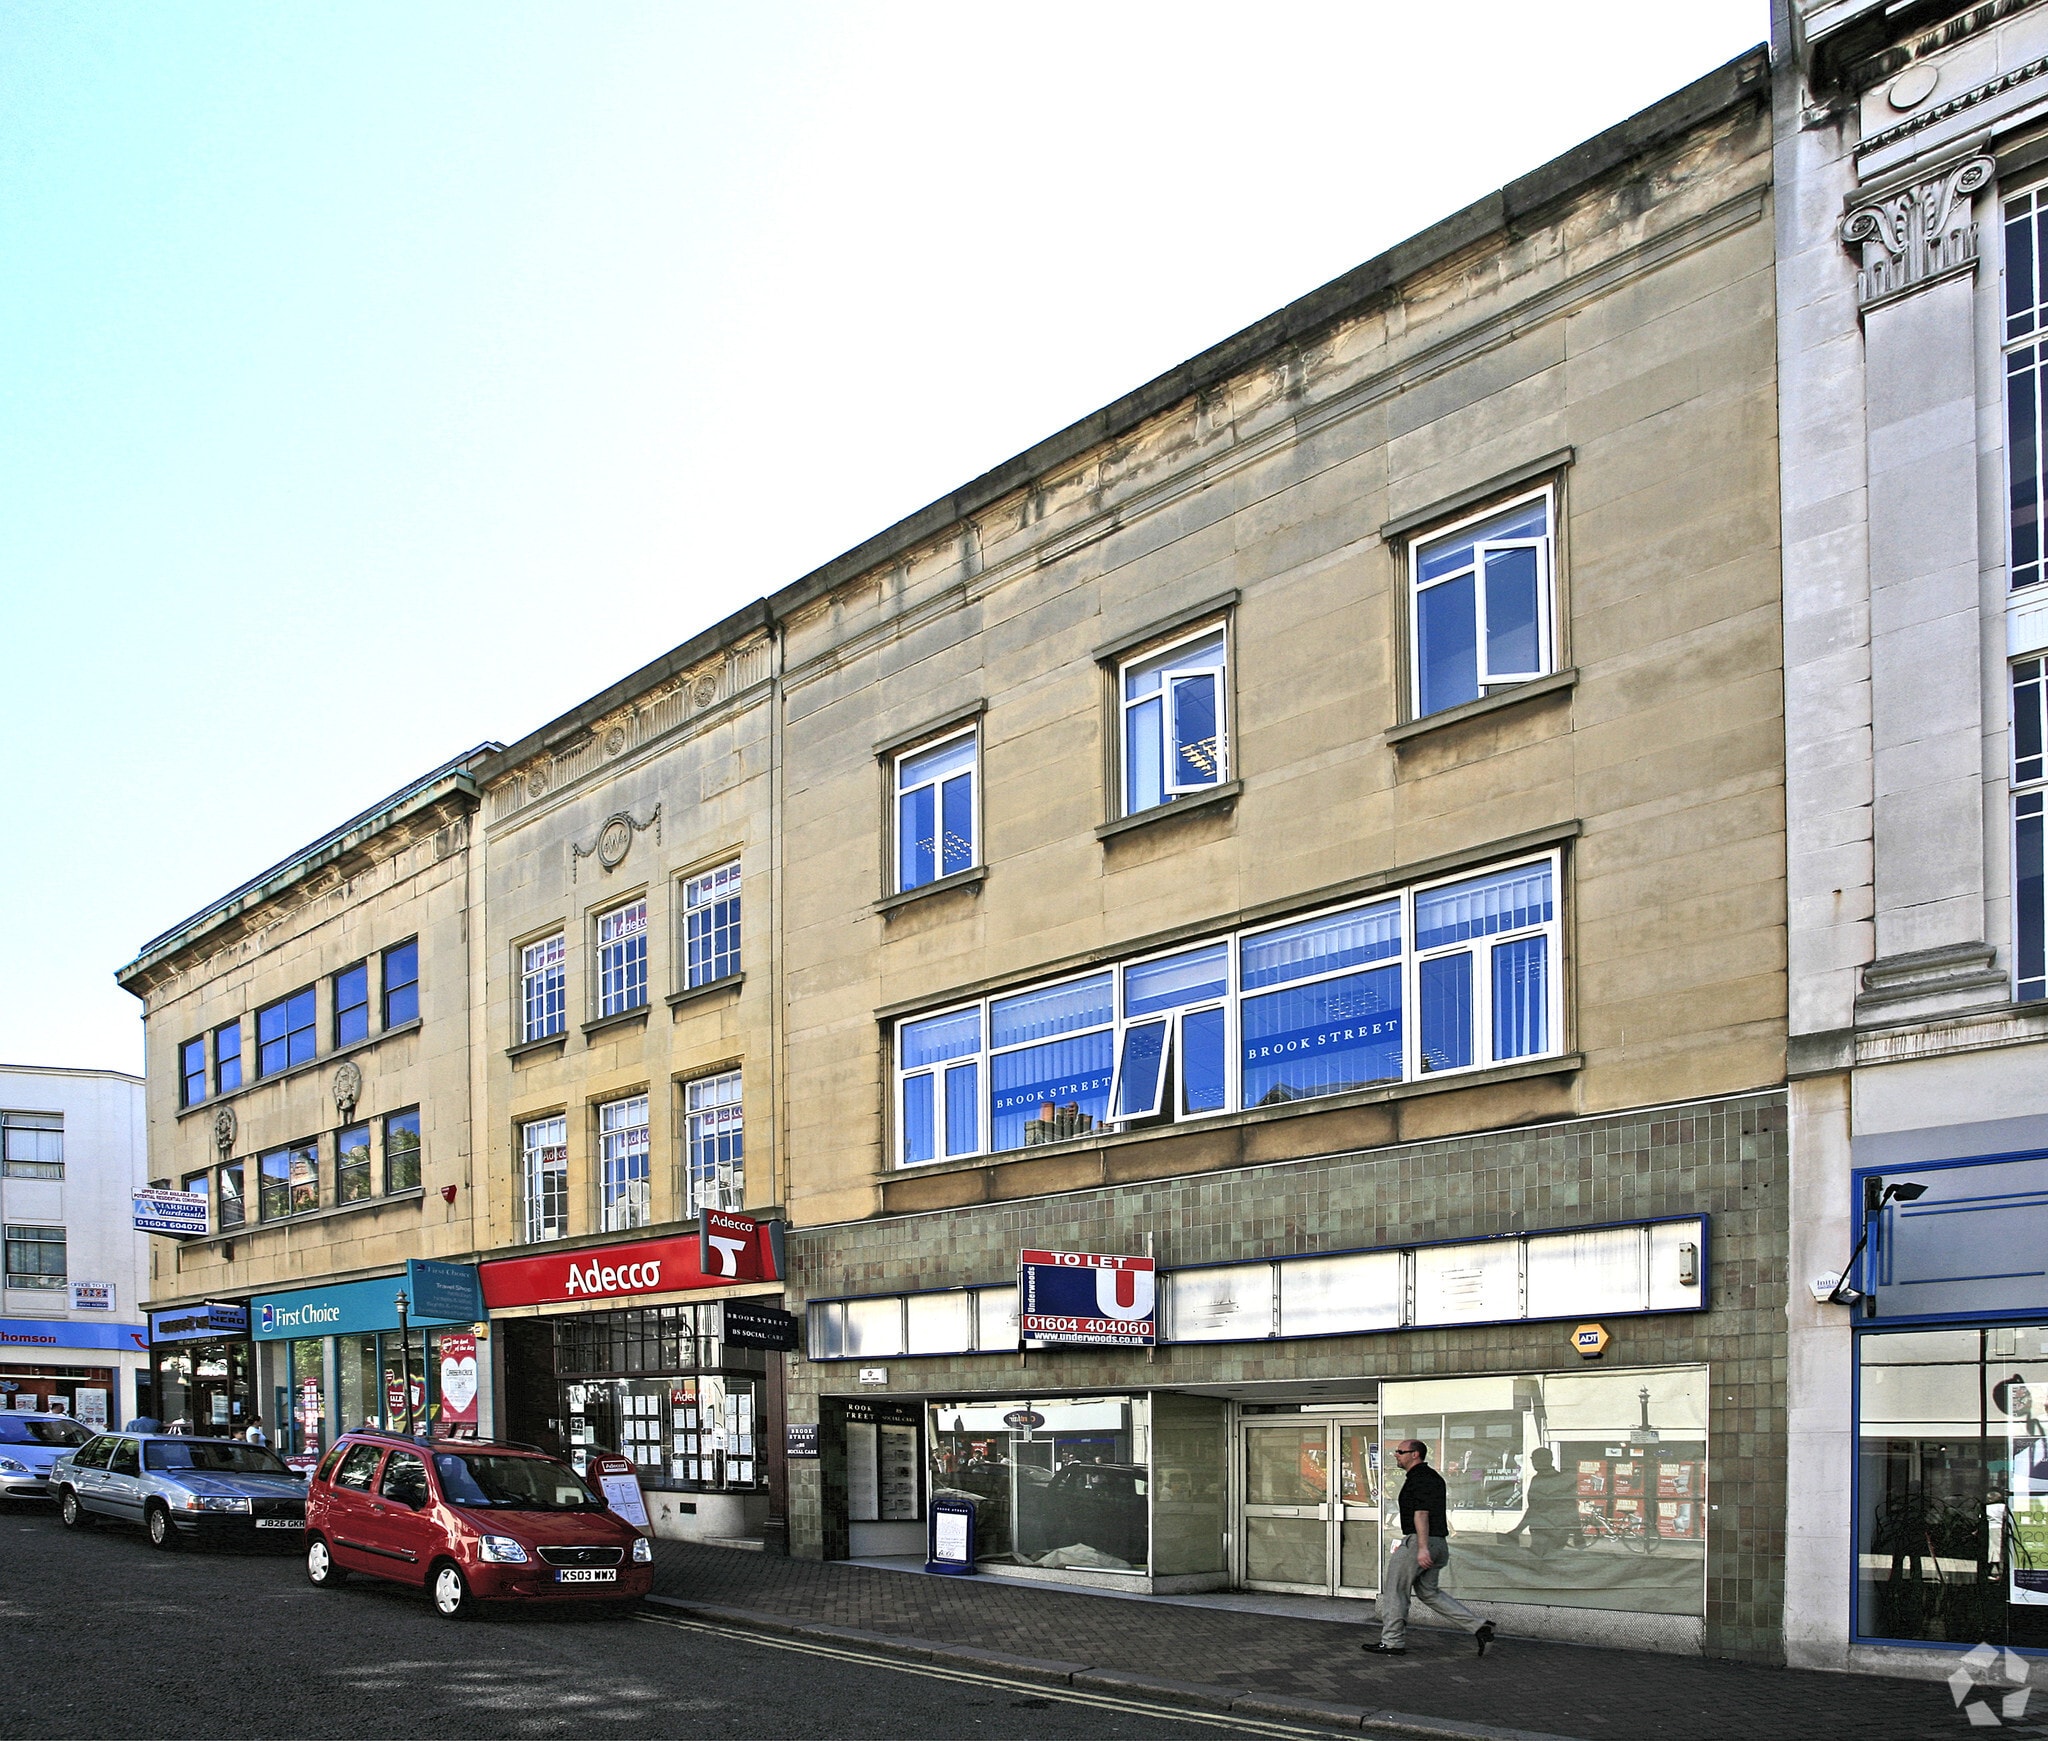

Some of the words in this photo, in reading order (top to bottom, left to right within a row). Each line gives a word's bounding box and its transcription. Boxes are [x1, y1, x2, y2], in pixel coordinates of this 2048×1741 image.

[1248, 1038, 1310, 1060] BROOK
[1317, 1020, 1398, 1046] STREET
[996, 1091, 1044, 1109] BROOK
[1049, 1076, 1111, 1098] STREET
[156, 1202, 204, 1212] MARRIOTT
[159, 1209, 206, 1218] Hardcastle
[169, 1222, 204, 1230] 604070
[710, 1214, 754, 1233] Adecco
[1051, 1252, 1080, 1266] TO
[1087, 1256, 1127, 1269] LET
[565, 1258, 661, 1295] Adecco
[1027, 1266, 1036, 1313] Underwoods
[211, 1316, 245, 1325] NERO
[276, 1308, 300, 1327] First
[301, 1302, 340, 1324] Choice
[726, 1312, 755, 1322] BROOK
[757, 1317, 789, 1327] STREET
[1027, 1316, 1078, 1331] 01604
[1085, 1320, 1150, 1335] 404060
[742, 1330, 766, 1339] SOCIAL
[1034, 1332, 1144, 1344] www.underwoods.co.uk
[1580, 1334, 1597, 1343] ADT
[848, 1404, 873, 1412] ROOK
[261, 1519, 286, 1527] J826
[562, 1570, 592, 1581] KS03
